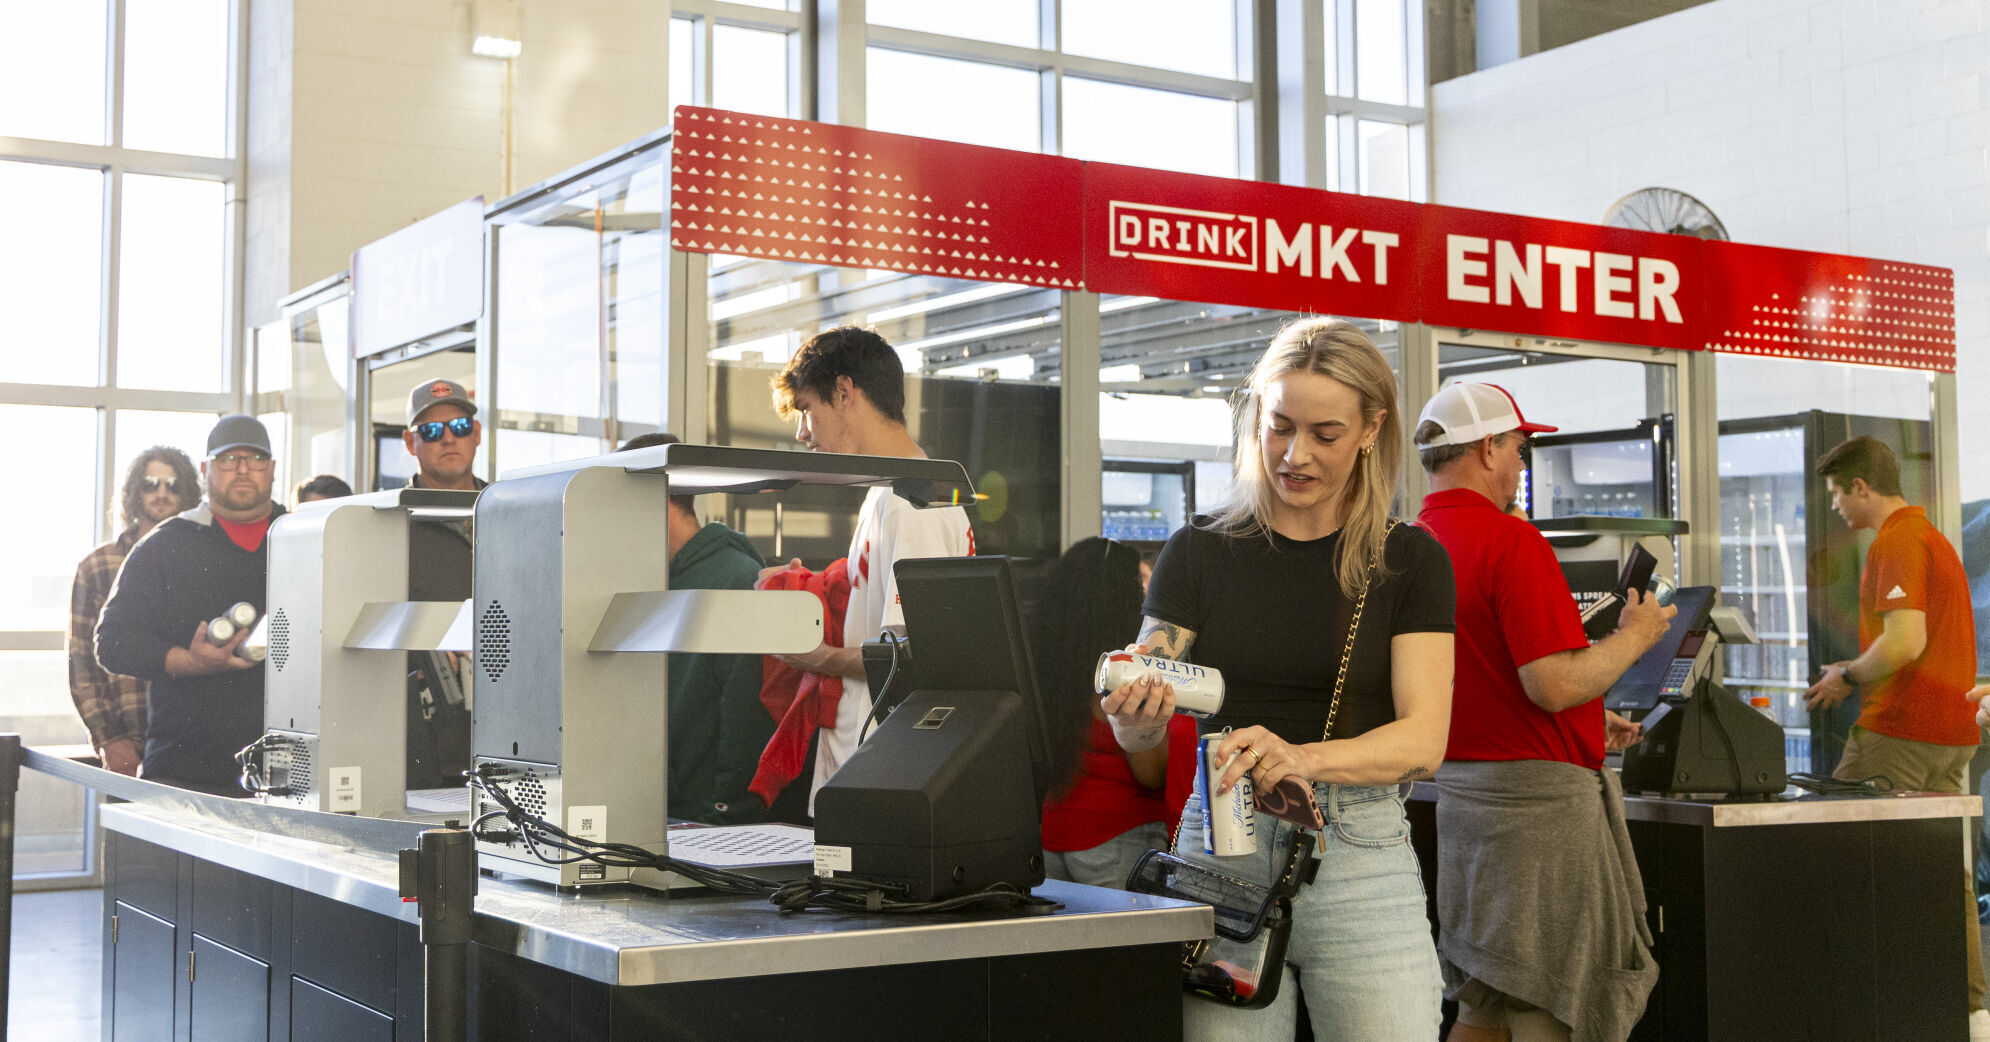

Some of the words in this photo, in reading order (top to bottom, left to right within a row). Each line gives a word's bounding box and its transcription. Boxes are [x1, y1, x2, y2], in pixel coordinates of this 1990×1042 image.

[377, 233, 455, 325] EXIT
[1119, 214, 1247, 258] DRINK
[1265, 218, 1400, 286] MKT
[1446, 234, 1684, 324] ENTER
[1140, 656, 1206, 678] ULTRA
[1242, 770, 1255, 837] ULTRA
